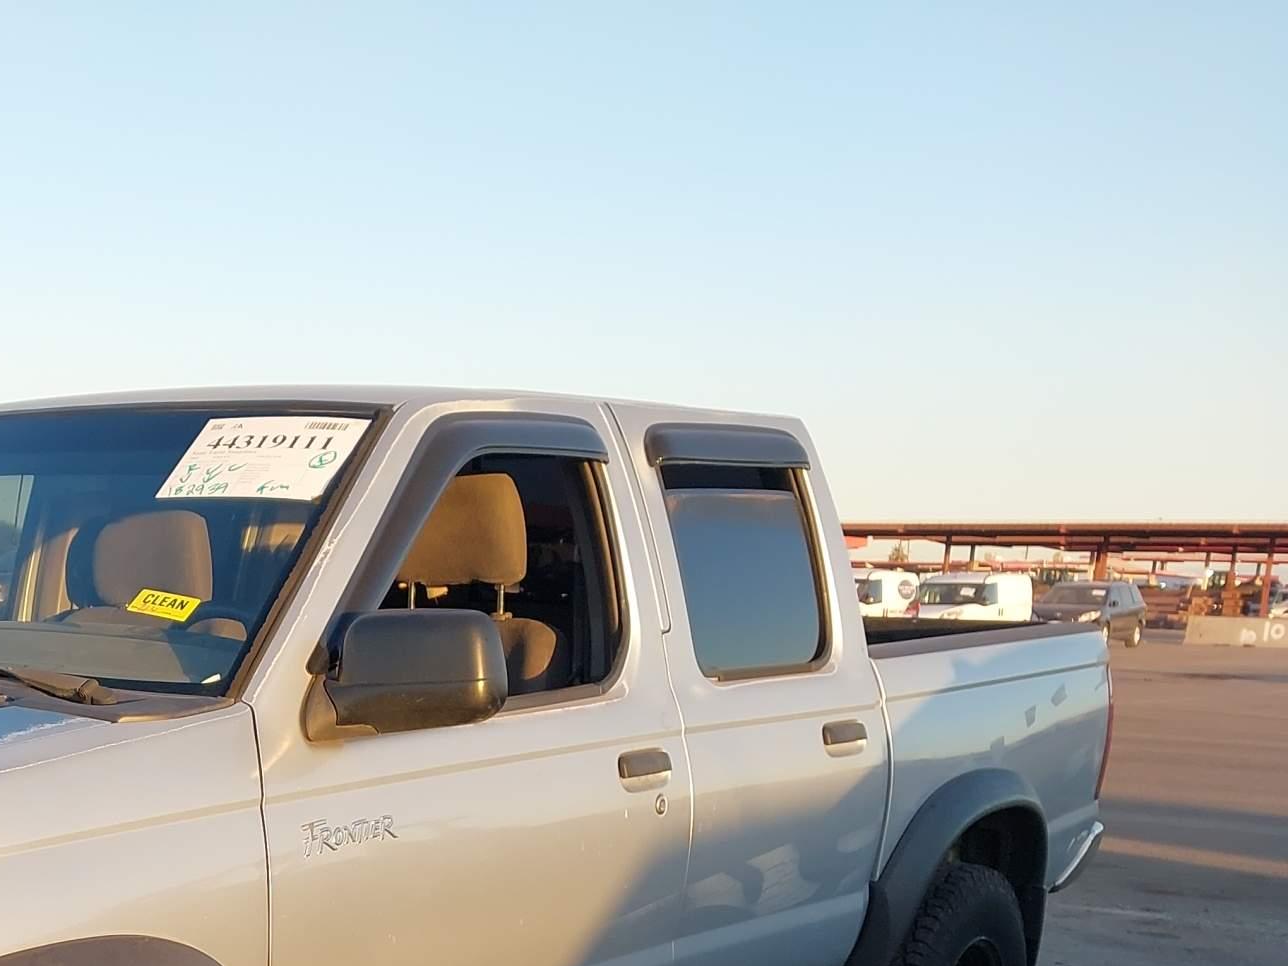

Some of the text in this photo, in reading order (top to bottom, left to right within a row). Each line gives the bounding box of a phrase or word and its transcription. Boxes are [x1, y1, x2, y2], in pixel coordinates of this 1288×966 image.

[206, 434, 334, 450] 44319111
[142, 594, 190, 610] CLEAN
[300, 815, 400, 858] FRONTIER
